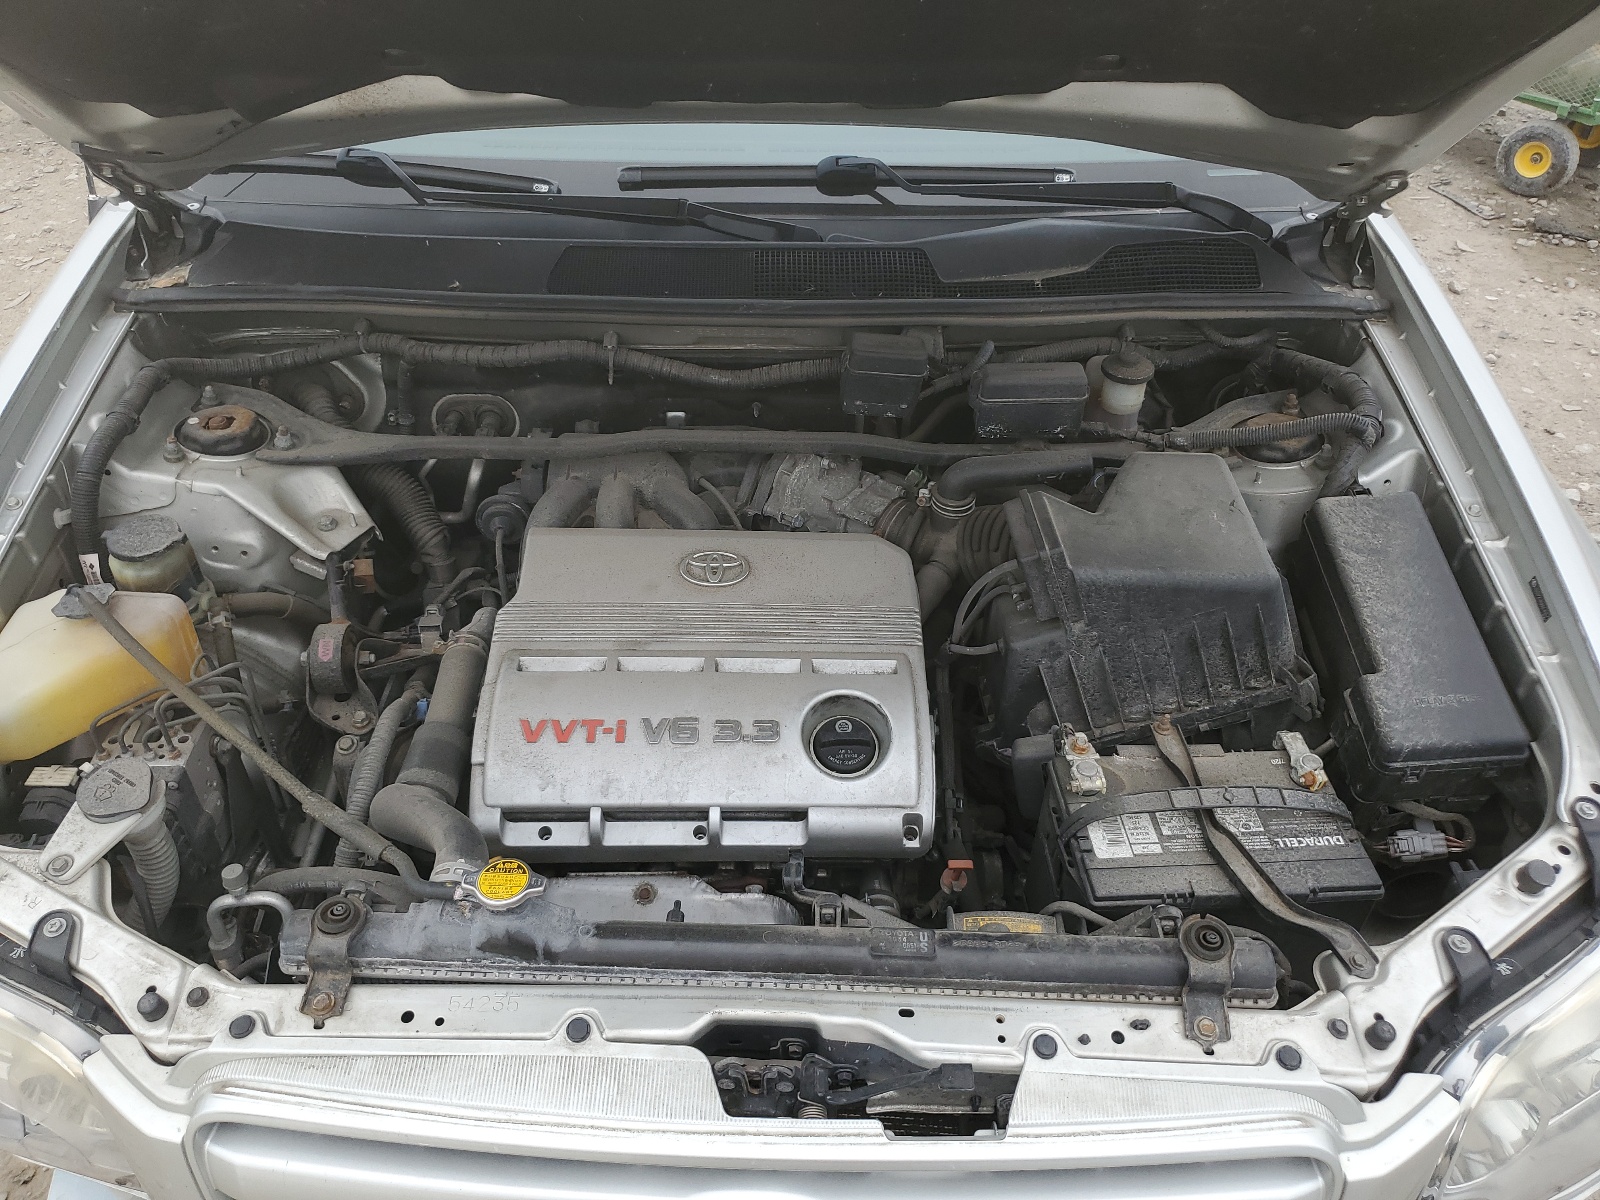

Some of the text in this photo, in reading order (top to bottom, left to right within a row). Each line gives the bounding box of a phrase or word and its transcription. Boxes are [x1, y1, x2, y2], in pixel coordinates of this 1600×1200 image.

[520, 716, 782, 745] VVT-i V6 3.3
[1273, 835, 1345, 847] DURACELL
[447, 995, 521, 1013] 54235
